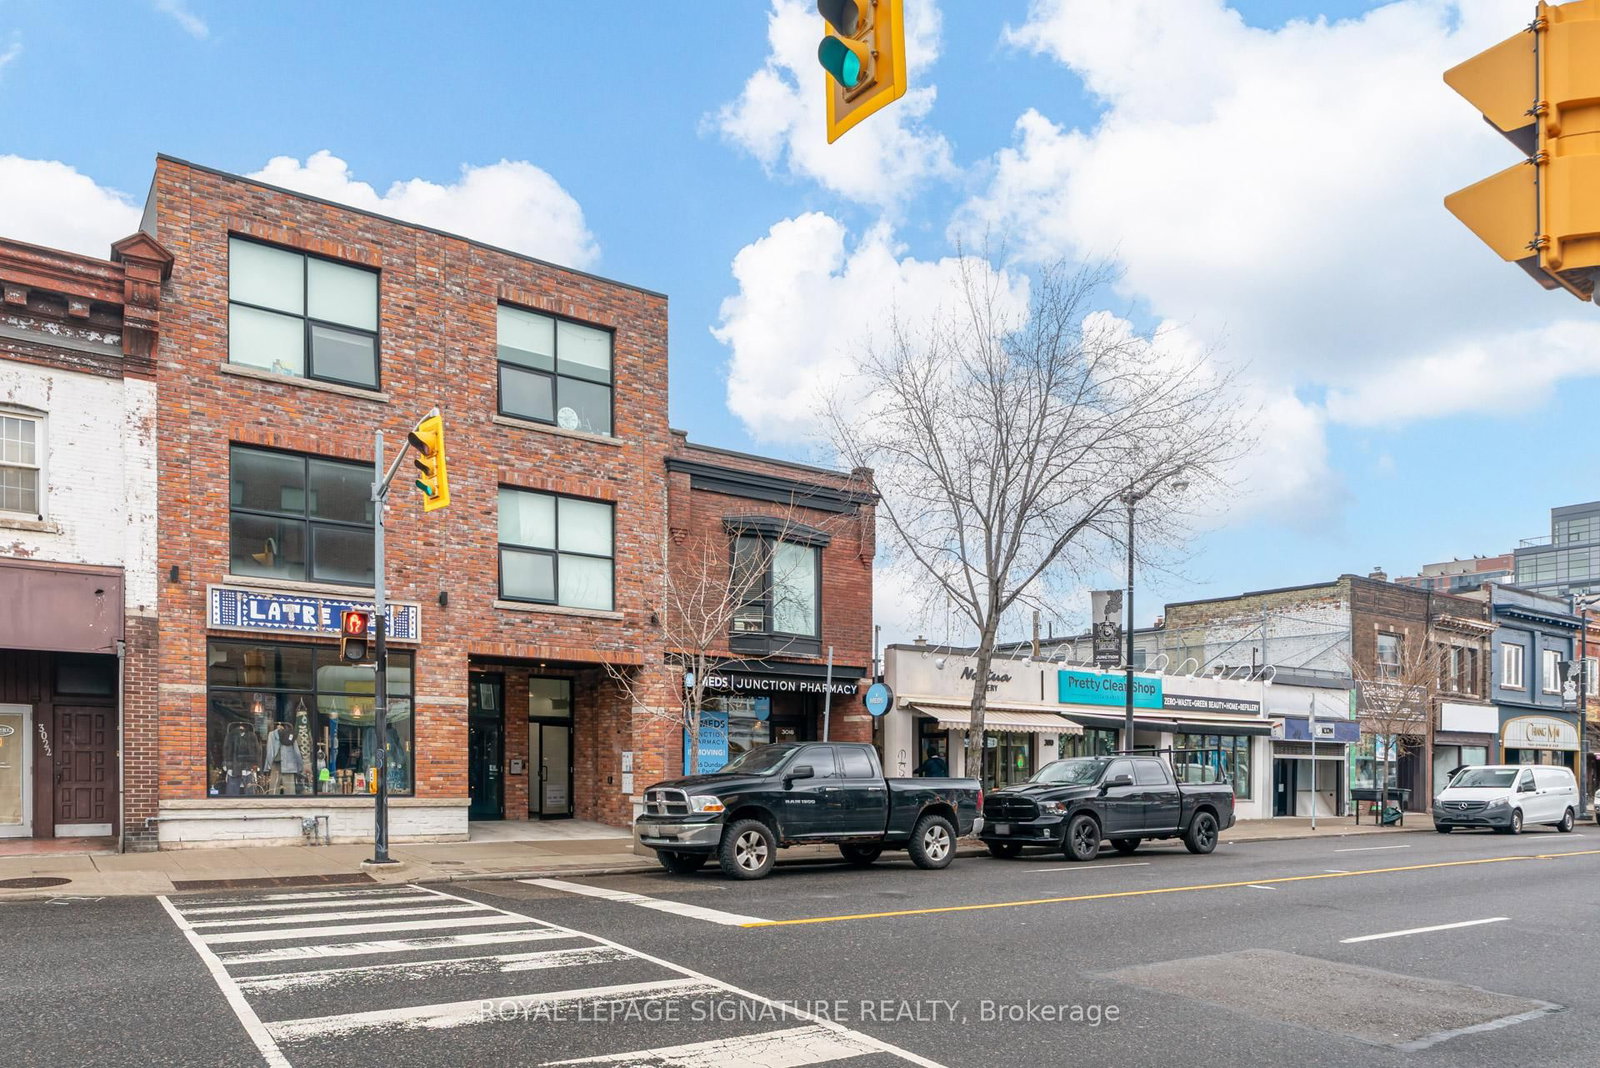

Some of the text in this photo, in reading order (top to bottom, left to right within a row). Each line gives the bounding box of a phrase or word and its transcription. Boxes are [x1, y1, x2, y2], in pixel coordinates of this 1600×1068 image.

[250, 600, 331, 625] LATRE
[960, 666, 1012, 682] Notua
[736, 679, 796, 691] JUNCTION
[800, 683, 857, 695] PHARMACY
[1068, 676, 1101, 692] Pretty
[1133, 681, 1156, 696] Shop
[38, 723, 52, 757] 3022
